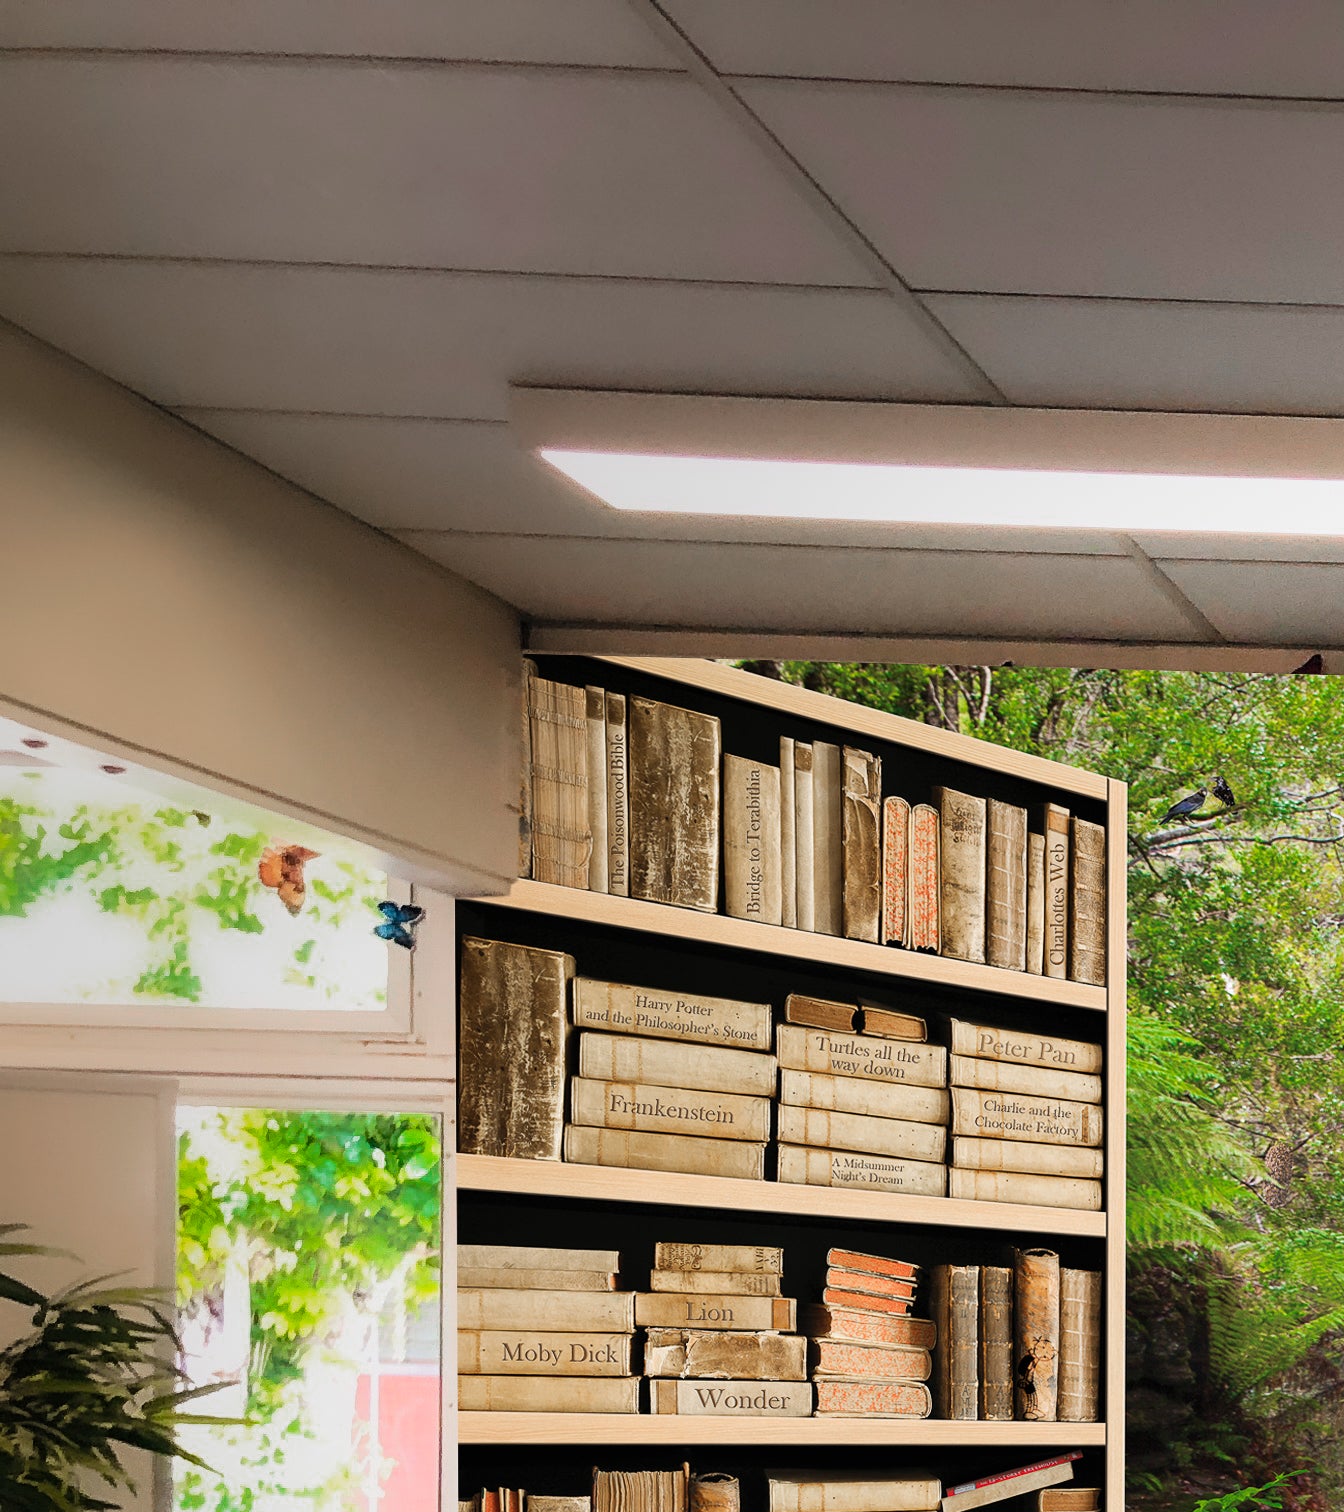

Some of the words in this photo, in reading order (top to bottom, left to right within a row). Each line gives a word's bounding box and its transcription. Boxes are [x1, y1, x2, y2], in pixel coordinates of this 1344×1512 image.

[611, 734, 625, 770] Bible
[611, 774, 625, 856] Poisonwood
[746, 769, 760, 843] Terabithia
[749, 848, 760, 862] to
[1050, 843, 1065, 882] Web
[611, 864, 625, 889] The
[746, 866, 763, 914] Bridge
[1050, 887, 1065, 965] Charlottes
[635, 995, 672, 1013] Harry
[676, 1000, 713, 1017] Potter
[585, 1010, 609, 1022] and
[613, 1012, 632, 1025] the
[636, 1014, 719, 1036] Philosopher's
[723, 1025, 758, 1041] Stone
[816, 1036, 869, 1057] Turtles
[874, 1045, 892, 1061] all
[897, 1048, 921, 1064] the
[978, 1034, 1032, 1058] Peter
[1037, 1041, 1076, 1064] Pan
[831, 1059, 859, 1074] way
[863, 1060, 905, 1078] down
[610, 1094, 734, 1124] Frankenstein
[984, 1100, 1025, 1113] Charlie
[1029, 1106, 1050, 1117] and
[1053, 1107, 1071, 1119] the
[975, 1115, 1032, 1131] Chocolate
[1036, 1121, 1078, 1137] Factory
[831, 1158, 840, 1167] A
[844, 1159, 905, 1172] Midsummer
[831, 1169, 866, 1182] Night's
[869, 1173, 903, 1185] Dream
[686, 1302, 735, 1321] Lion
[502, 1342, 563, 1366] Moby
[570, 1343, 619, 1363] Dick
[695, 1388, 790, 1409] Wonder
